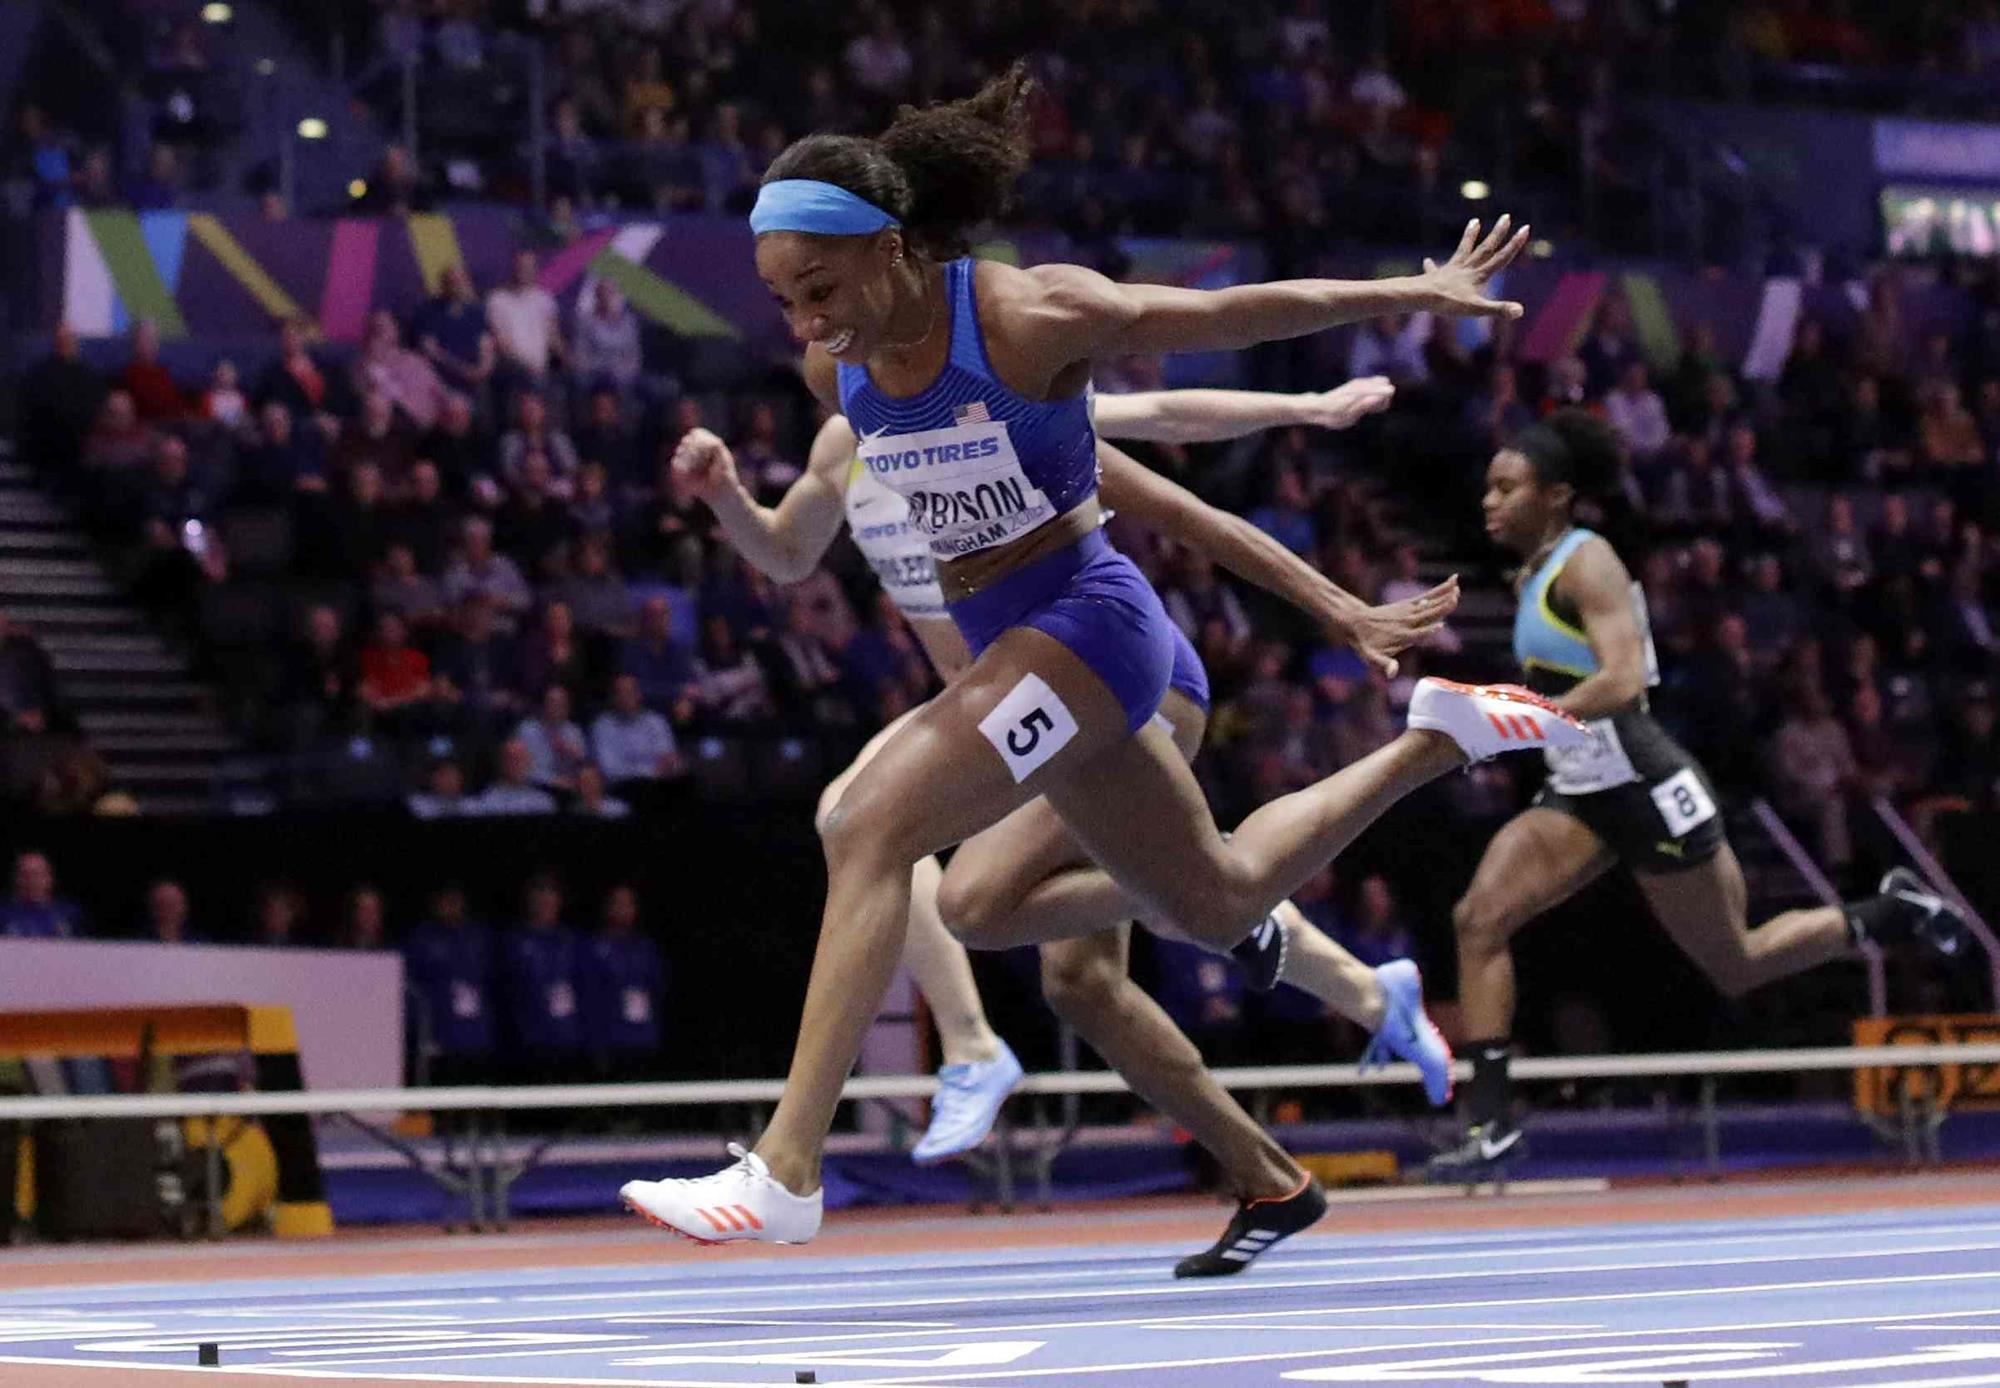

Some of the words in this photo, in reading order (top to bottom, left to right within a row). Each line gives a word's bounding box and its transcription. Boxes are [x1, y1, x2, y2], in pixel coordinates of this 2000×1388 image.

[865, 449, 921, 474] TOYO
[923, 436, 999, 466] TIRES
[1007, 707, 1054, 757] 5
[1673, 785, 1697, 818] 8
